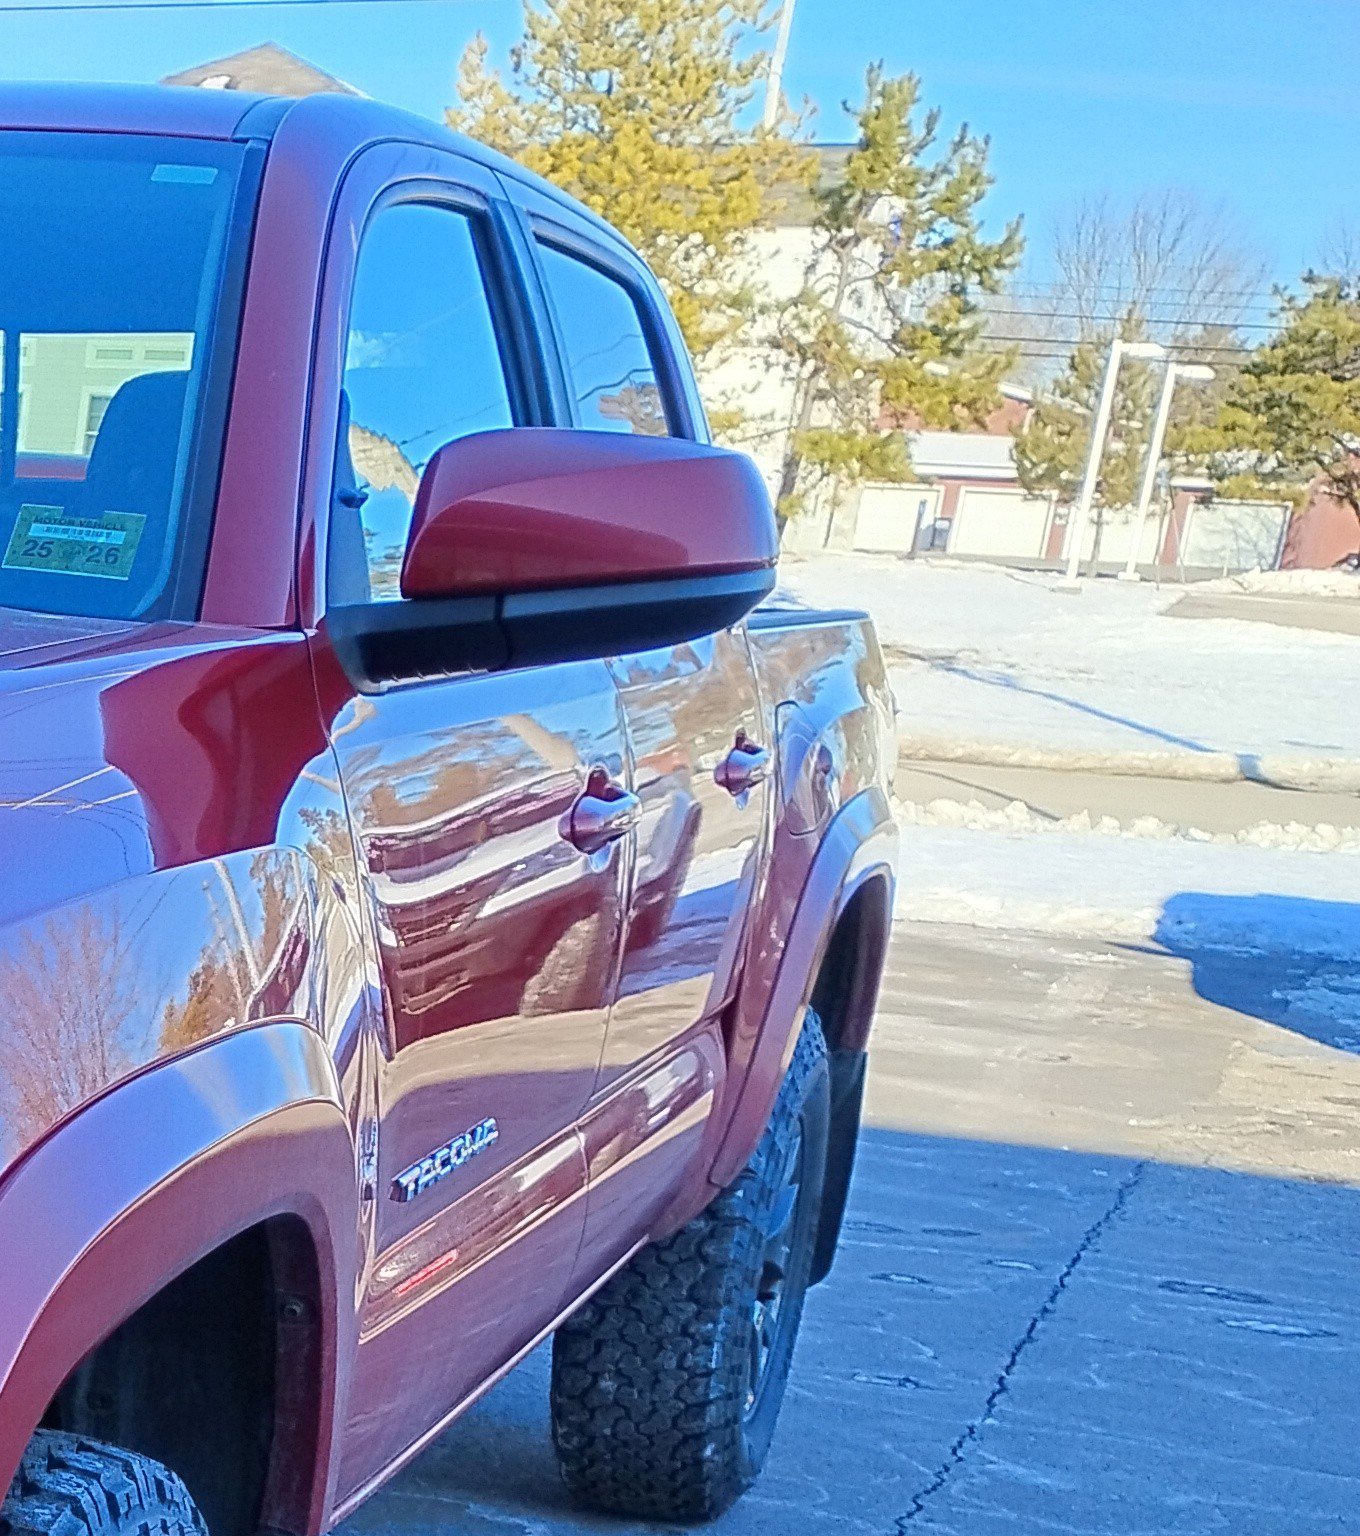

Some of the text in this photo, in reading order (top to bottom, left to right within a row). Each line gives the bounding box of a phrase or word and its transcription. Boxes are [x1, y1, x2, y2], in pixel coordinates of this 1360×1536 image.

[21, 539, 122, 565] 25 26
[398, 1117, 499, 1201] TACOMA
